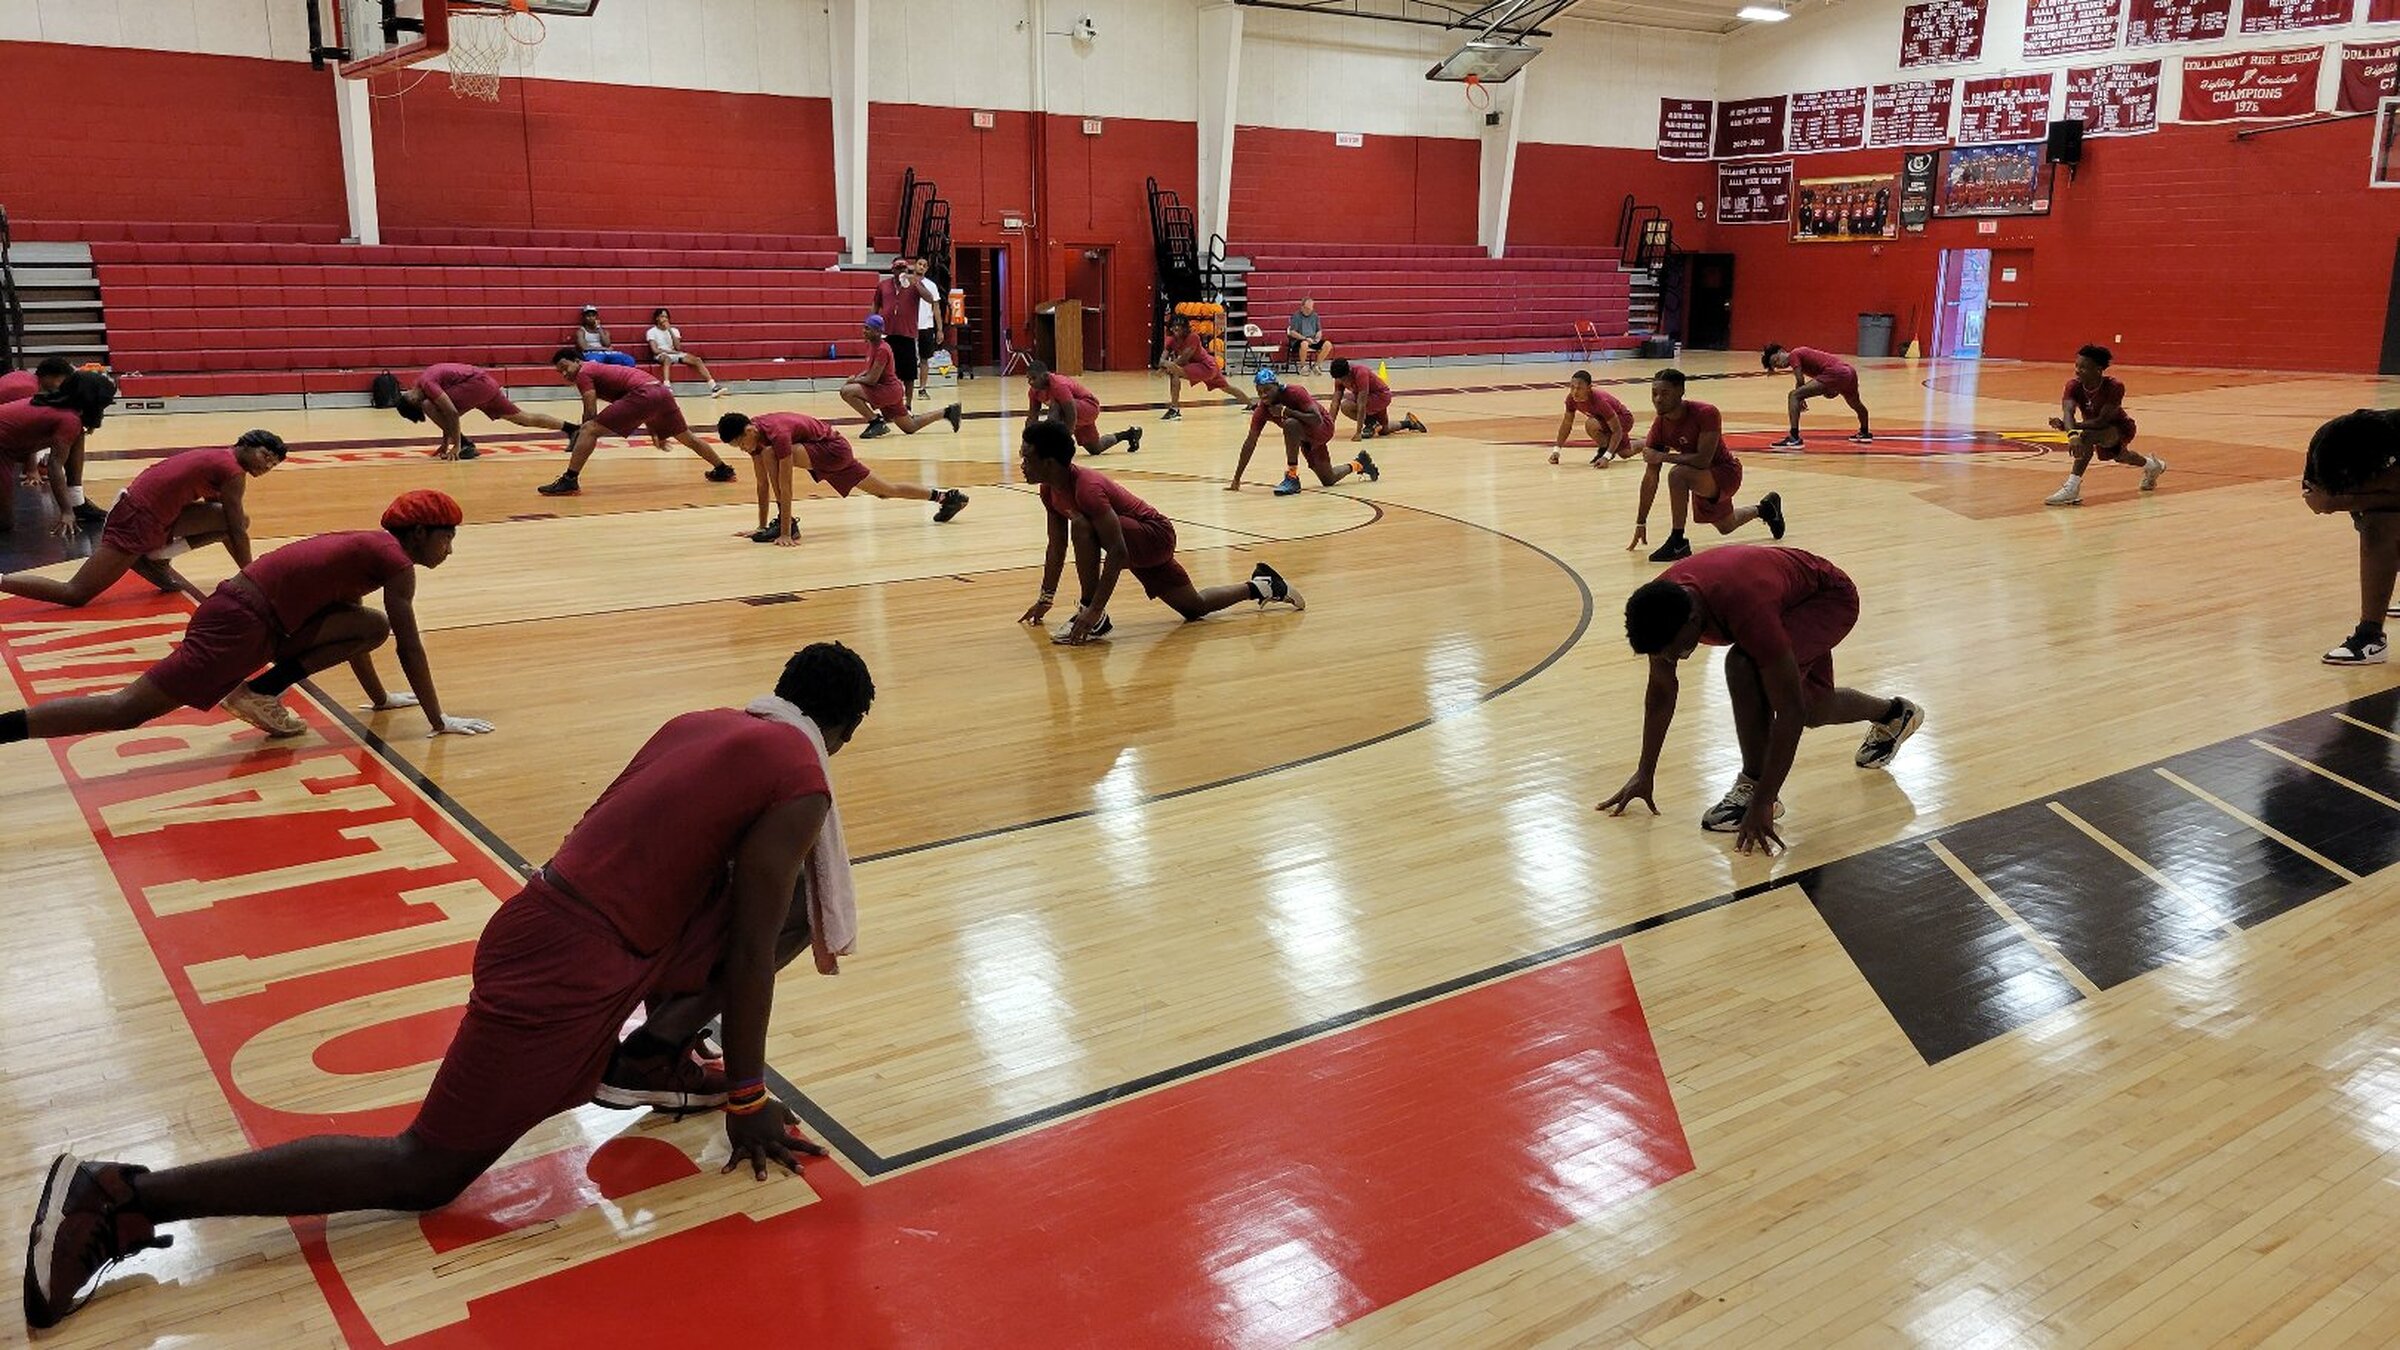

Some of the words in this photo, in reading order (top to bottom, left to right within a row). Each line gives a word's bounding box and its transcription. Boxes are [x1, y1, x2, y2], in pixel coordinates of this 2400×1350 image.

[2184, 56, 2247, 71] DOLLARWAY
[2250, 55, 2276, 65] HIGH
[2281, 51, 2321, 65] SCHOOL
[2200, 78, 2236, 91] Fighting
[2257, 73, 2298, 85] Cardinals
[2212, 88, 2283, 103] CHAMPIONS
[2234, 101, 2260, 113] 1976
[2, 612, 822, 1346] DOLLARAY
